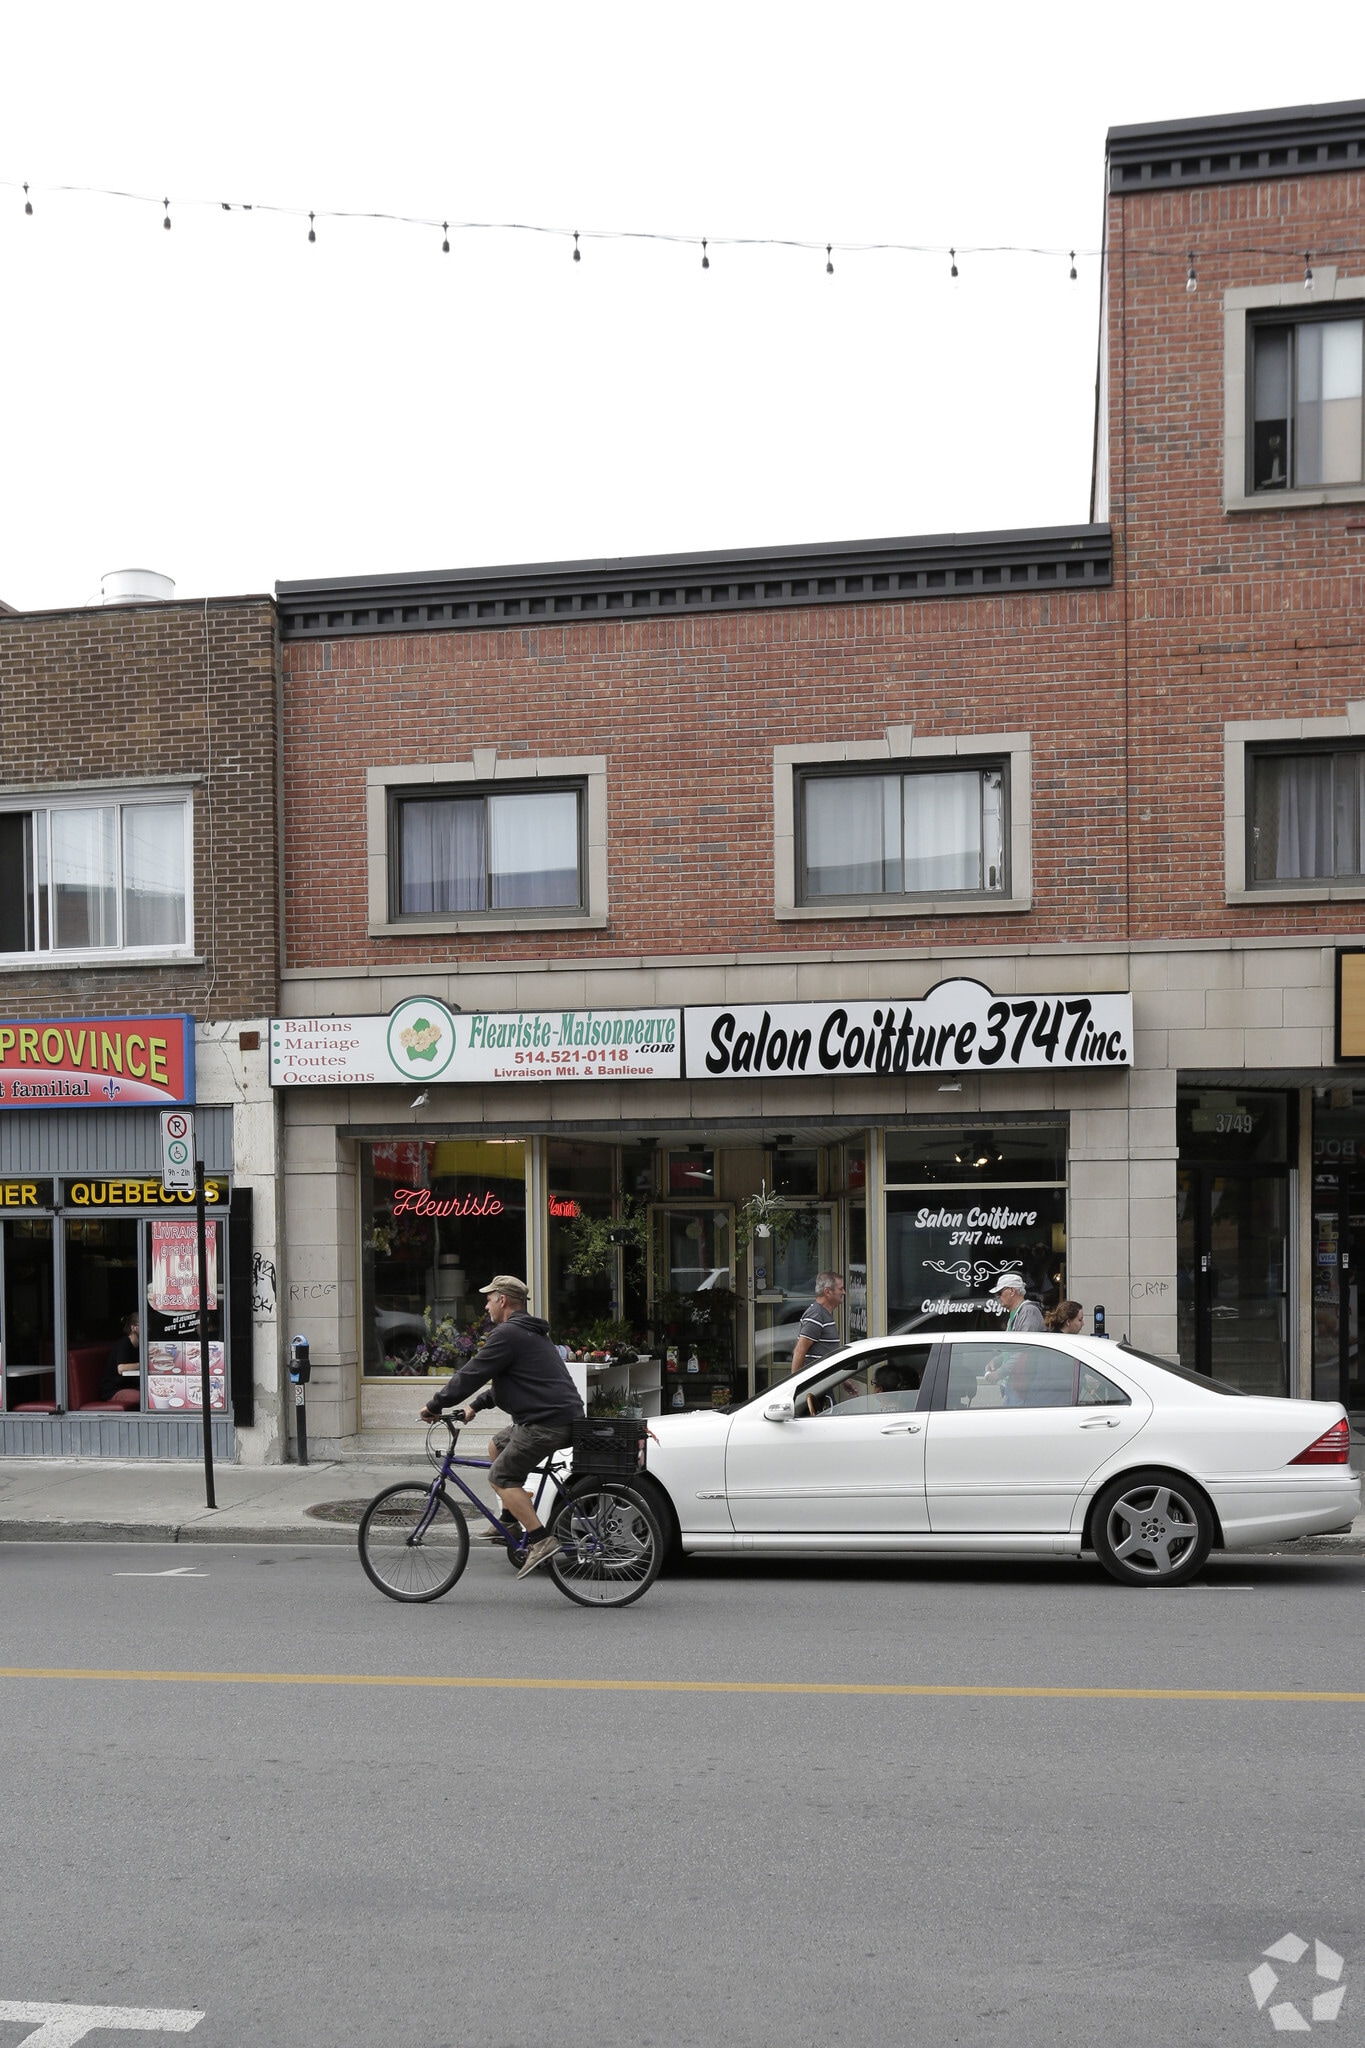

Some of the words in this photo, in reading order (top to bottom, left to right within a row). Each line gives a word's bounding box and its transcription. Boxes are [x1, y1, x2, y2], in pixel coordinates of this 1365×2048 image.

[285, 1021, 351, 1032] Ballons
[705, 1010, 811, 1074] Salon
[819, 1006, 976, 1073] Coiffure
[979, 999, 1091, 1065] 3747
[1080, 1020, 1126, 1062] inc.
[285, 1037, 359, 1051] Mariage
[635, 1044, 675, 1053] .com
[0, 1028, 168, 1084] PROVINCE
[284, 1055, 346, 1066] Toutes
[515, 1049, 628, 1063] 514.521-0118
[283, 1071, 374, 1083] Occasions
[494, 1068, 551, 1077] Livraison
[556, 1067, 579, 1076] Mtl.
[584, 1066, 593, 1075] &
[598, 1066, 653, 1075] Banlieue
[11, 1080, 90, 1097] familial
[1216, 1114, 1252, 1133] 3749
[0, 1185, 38, 1205] ER
[393, 1189, 503, 1217] Fleuriste
[915, 1208, 963, 1228] Salon
[967, 1206, 1037, 1229] Coiffure
[154, 1226, 215, 1239] LIVRAISN
[949, 1231, 982, 1245] 3747
[984, 1233, 1003, 1245] inc.
[166, 1274, 200, 1289] rapid
[921, 1299, 974, 1314] Coiffeuse
